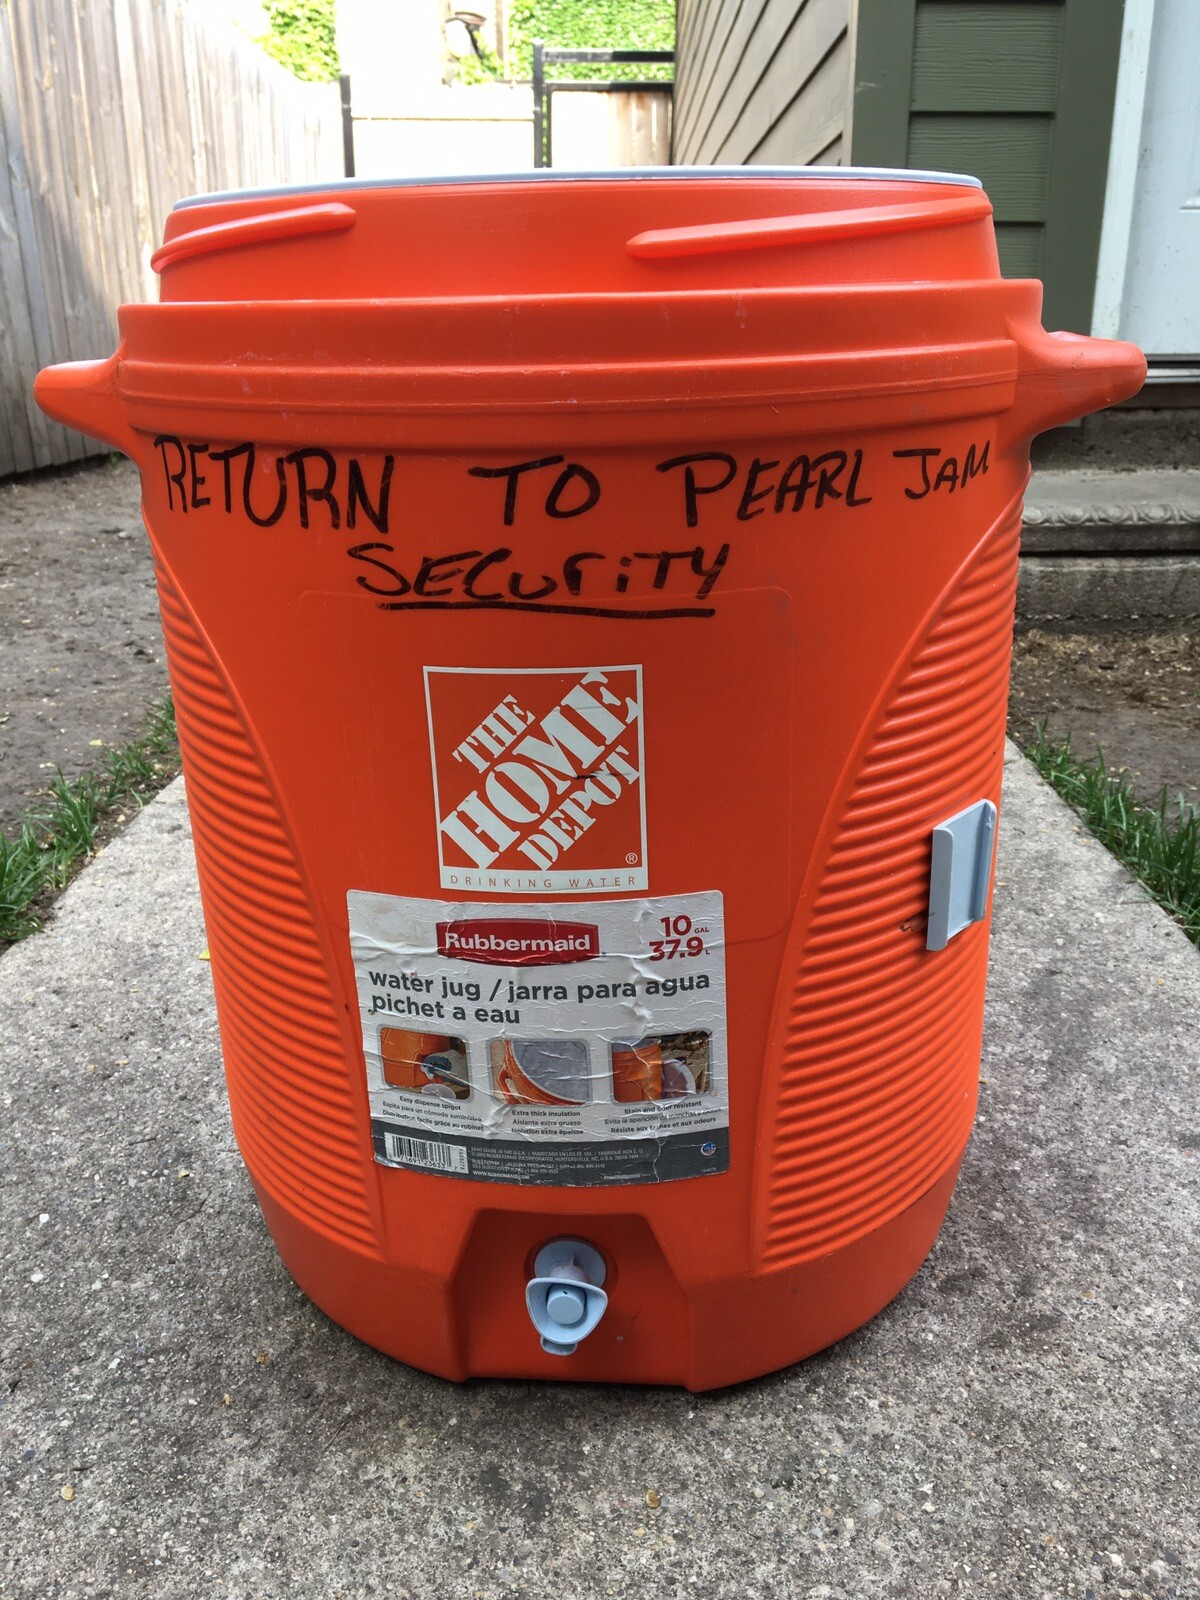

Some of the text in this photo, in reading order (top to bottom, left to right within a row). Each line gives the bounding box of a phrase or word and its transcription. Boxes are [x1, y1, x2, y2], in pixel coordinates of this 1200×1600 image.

[154, 434, 990, 534] RETURN TO PEARL JAM
[451, 694, 536, 774] THE
[440, 670, 639, 870] HOME
[517, 745, 640, 871] DEPOT
[450, 874, 635, 888] DRINKING WATER
[660, 915, 710, 937] 10 GAL
[445, 932, 590, 952] Rubbermaid
[649, 936, 704, 961] 37.9
[368, 970, 710, 1003] water jug / jarra para agua
[372, 992, 521, 1024] pichet a eau
[399, 1095, 461, 1111] Easy dispense spigot
[401, 1105, 414, 1113] para
[511, 1109, 530, 1117] Extra
[673, 1100, 702, 1109] resistant
[461, 1123, 484, 1131] robinet
[604, 1117, 621, 1125] Evita
[629, 1115, 658, 1125] aparición
[610, 1125, 635, 1134] Résiste
[694, 1115, 716, 1124] odeurs
